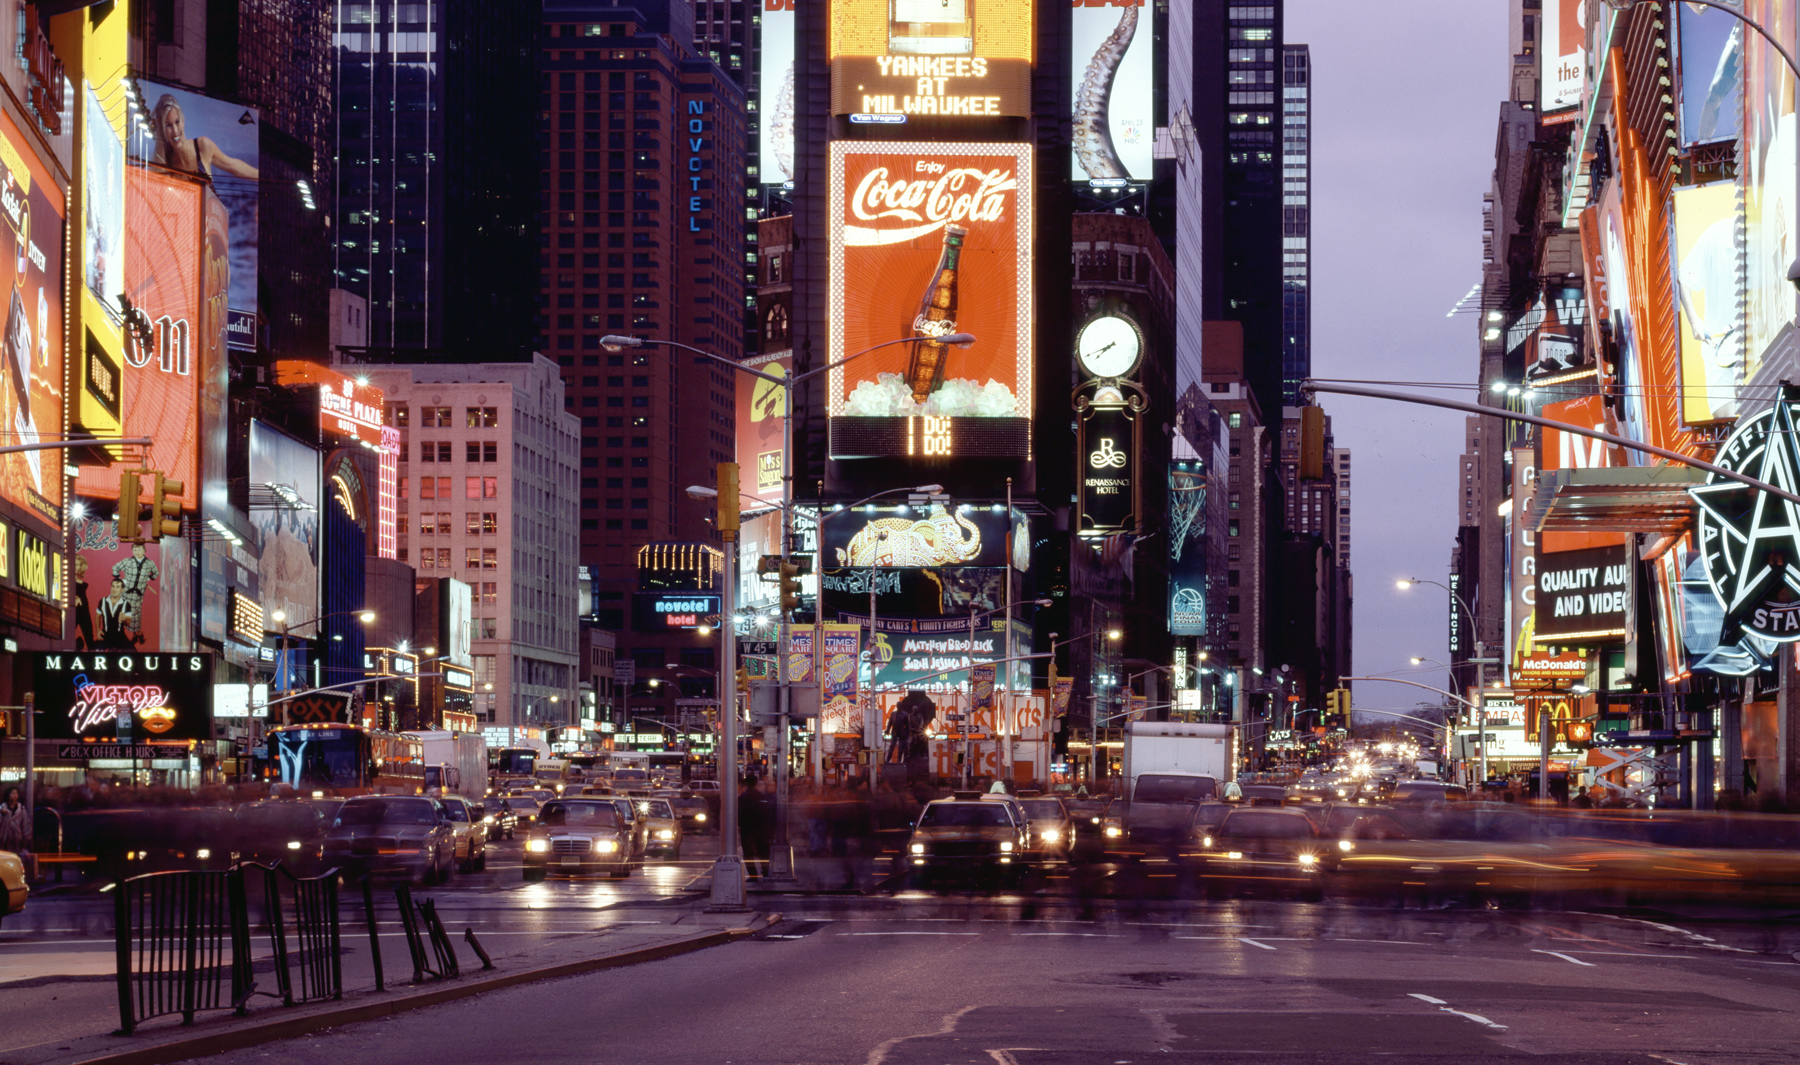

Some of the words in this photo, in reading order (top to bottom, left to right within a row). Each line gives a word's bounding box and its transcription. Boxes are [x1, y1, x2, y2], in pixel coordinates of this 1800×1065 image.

[876, 55, 988, 77] YANKEES
[1558, 62, 1580, 82] the
[916, 76, 949, 96] AT
[862, 95, 1001, 115] MILWAUKEE
[855, 114, 873, 123] Van
[874, 114, 904, 124] Wagner
[688, 100, 703, 232] NOVOTEL
[915, 160, 946, 174] Enjoy
[851, 166, 1017, 223] Coca-Cola
[354, 401, 381, 426] PLAZA
[338, 418, 357, 434] HOTEL
[924, 435, 951, 456] DO!
[759, 469, 781, 487] Saigon
[1085, 478, 1131, 486] RENAISSANCE
[19, 528, 47, 596] Kodak
[1541, 567, 1598, 592] QUALITY
[655, 599, 709, 612] novotel
[1554, 595, 1584, 617] AND
[667, 614, 696, 625] hotel
[847, 616, 885, 629] BROADAY
[887, 620, 909, 630] CARES
[966, 617, 981, 628] ADS
[743, 643, 751, 654] W
[754, 642, 767, 654] 45
[825, 638, 857, 646] TIMES
[825, 645, 857, 653] SQUARE
[904, 638, 947, 653] MATTHEW
[947, 638, 994, 652] BRODRICK
[46, 656, 202, 671] MARQUIS
[904, 656, 929, 670] SARAH
[930, 656, 960, 671] JESSICA
[1523, 660, 1586, 669] McDonald's
[939, 672, 948, 681] IN
[80, 685, 164, 705] VICTOR
[68, 691, 171, 733] Vicria
[274, 697, 343, 722] ROXY
[1270, 730, 1291, 741] CATS
[92, 746, 122, 758] OFFICE
